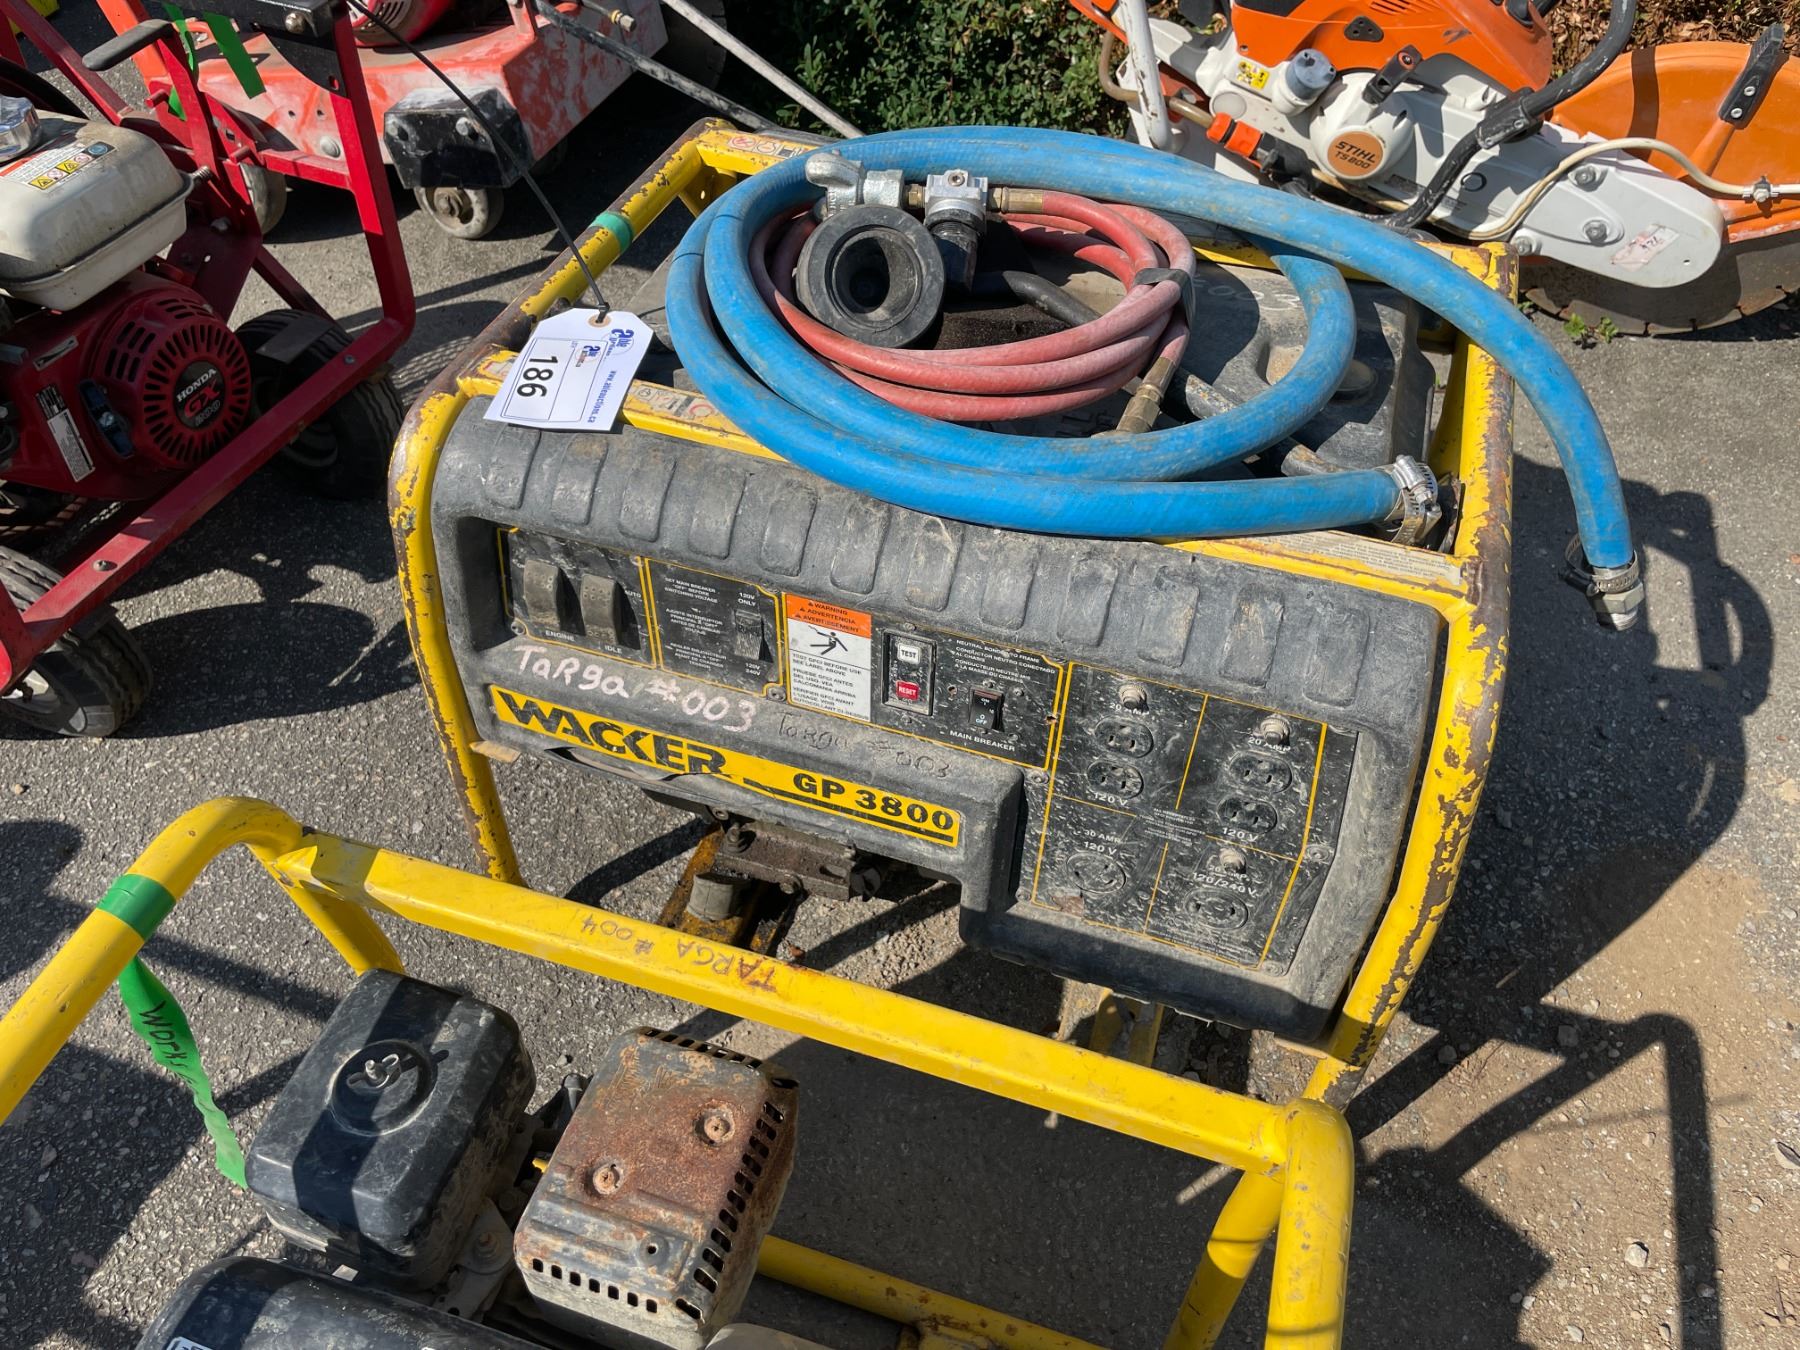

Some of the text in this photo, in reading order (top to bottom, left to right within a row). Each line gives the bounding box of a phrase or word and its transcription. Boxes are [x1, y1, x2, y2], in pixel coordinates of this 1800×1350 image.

[1336, 141, 1376, 164] STIHL
[516, 356, 558, 397] 186
[176, 368, 216, 402] HONDA
[184, 379, 220, 418] GX
[587, 370, 617, 424] www.ableauctions.ca
[738, 598, 756, 607] ONLY
[814, 602, 848, 616] WARNING
[803, 616, 859, 632] AVERTISSEMENT
[808, 608, 856, 625] ADVERTENCIA
[545, 630, 575, 641] ENGINE
[604, 645, 622, 654] IDLE
[900, 649, 917, 659] TEST
[956, 640, 983, 650] NEUTRAL
[984, 646, 1009, 658] BOND
[1019, 653, 1040, 664] FRAME
[824, 661, 848, 672] BEFORE
[956, 646, 1056, 674] CONDUCTOR NEUTRO CONECTADO
[805, 662, 824, 670] LABEL
[825, 667, 846, 676] ABOVE
[954, 659, 994, 672] CONDUCTEUR
[996, 668, 1018, 678] NEUTRE
[898, 686, 917, 696] RESET
[1109, 702, 1122, 711] 20
[498, 690, 726, 775] WACKER
[950, 730, 1016, 752] MAIN BREAKER
[1248, 736, 1262, 746] 20
[793, 772, 954, 830] GP 3800
[1094, 792, 1128, 806] 120 V
[1222, 827, 1258, 842] 120 V
[1084, 841, 1118, 855] 120 V
[675, 938, 777, 993] TARGA
